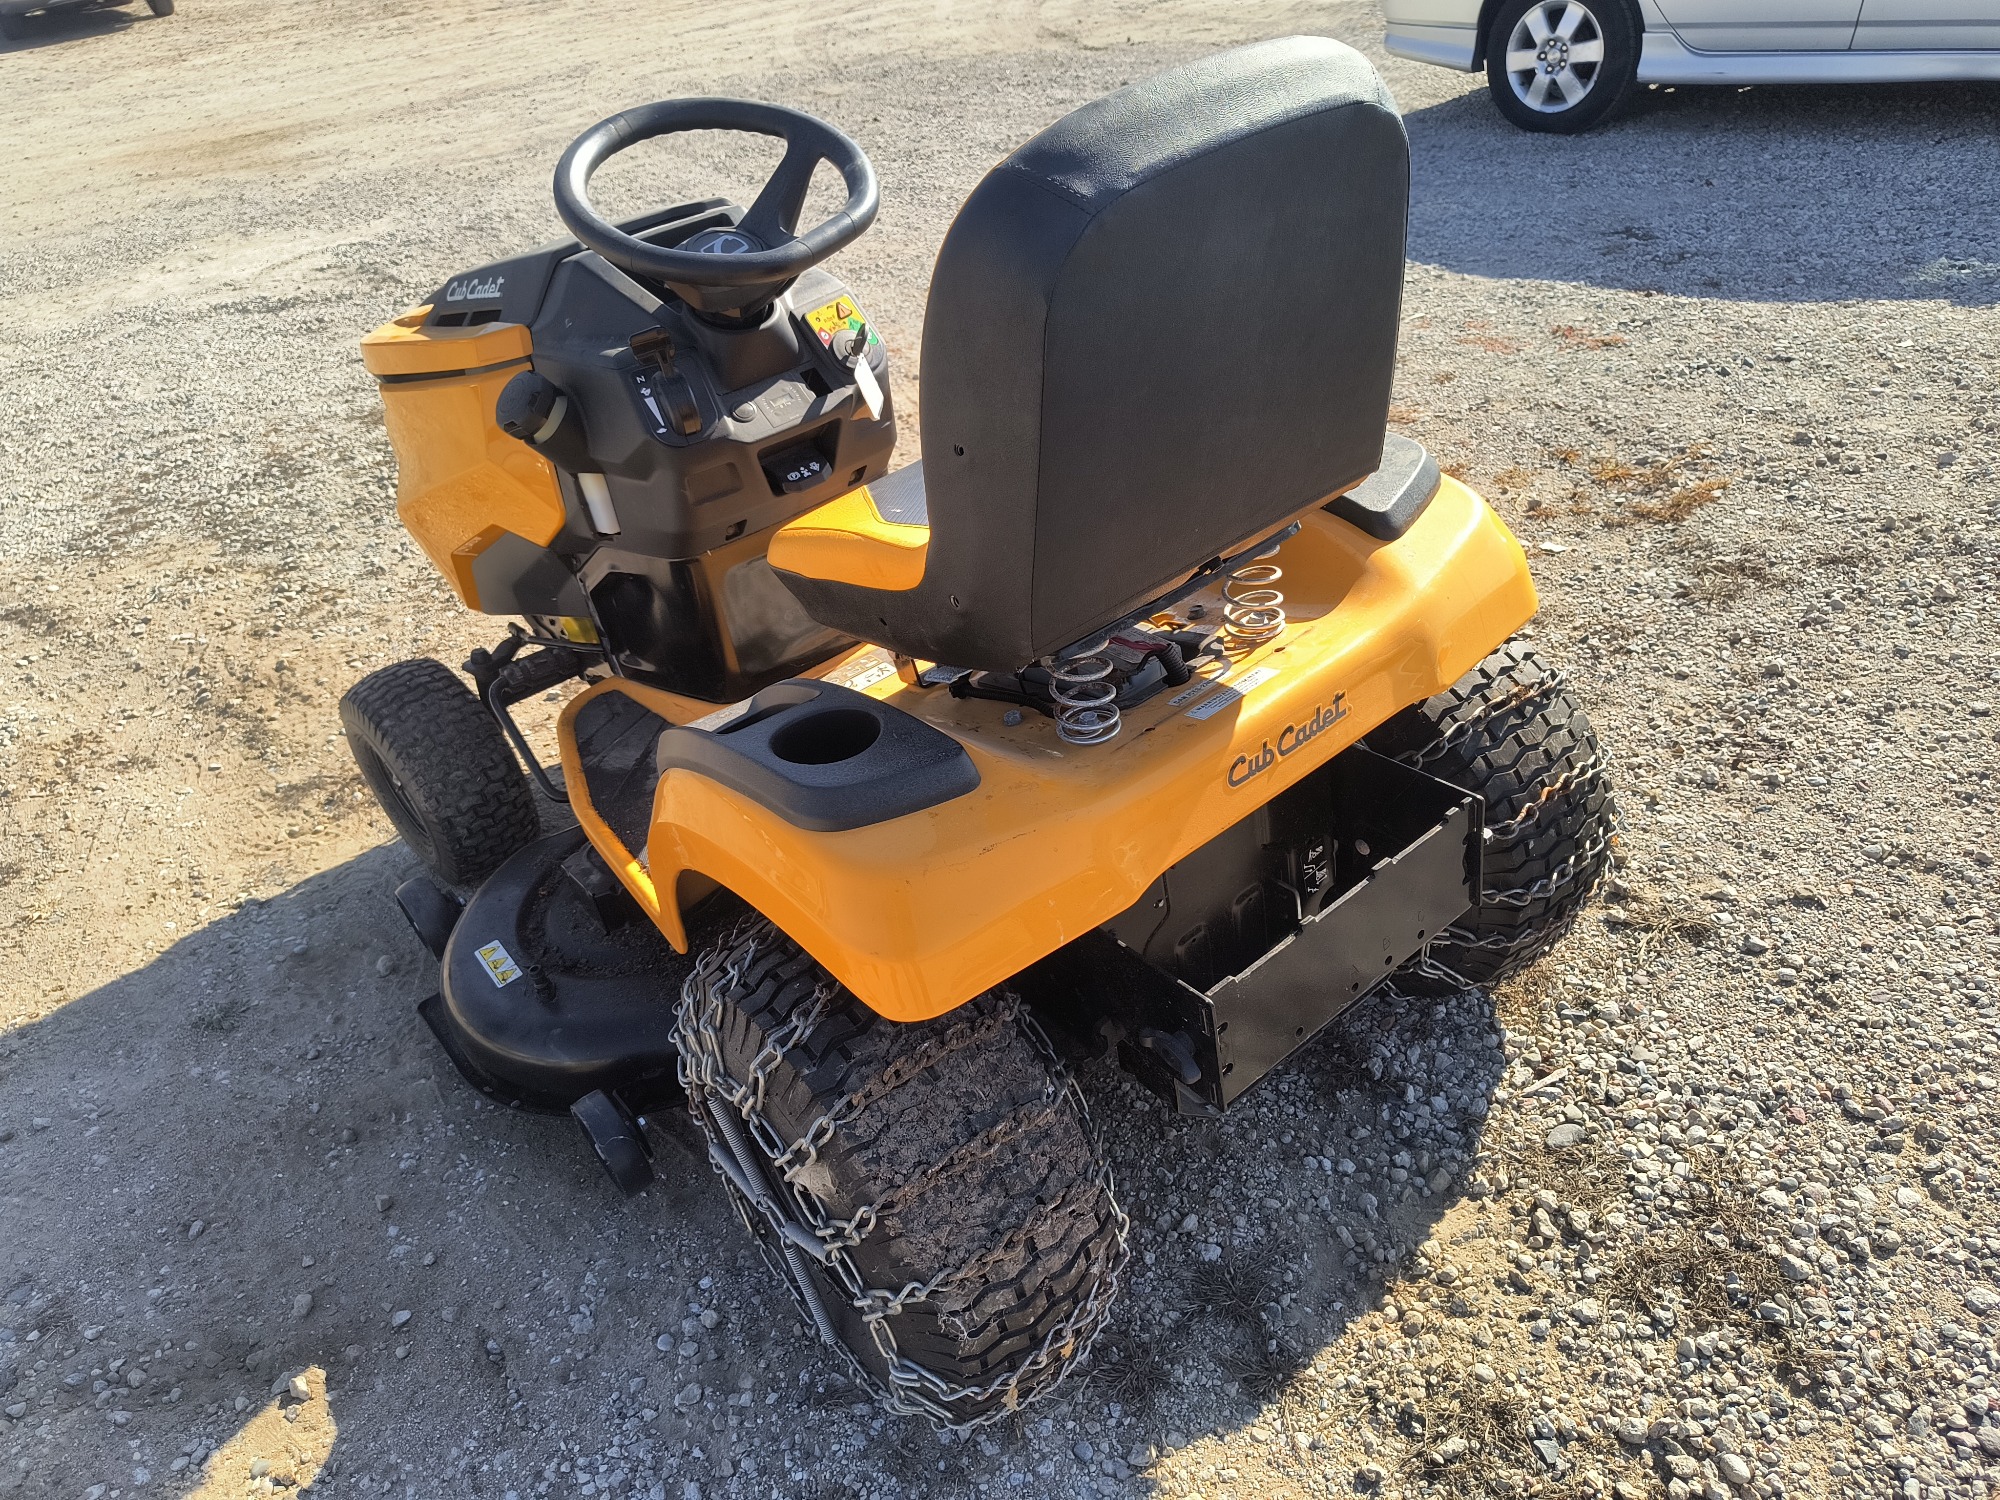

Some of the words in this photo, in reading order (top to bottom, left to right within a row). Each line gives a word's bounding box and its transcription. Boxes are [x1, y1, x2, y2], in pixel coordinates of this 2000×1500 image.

[446, 280, 467, 302] Cub
[466, 276, 505, 300] Cadet
[636, 375, 646, 384] N
[1227, 740, 1275, 788] Cub
[1277, 691, 1347, 757] Cadet
